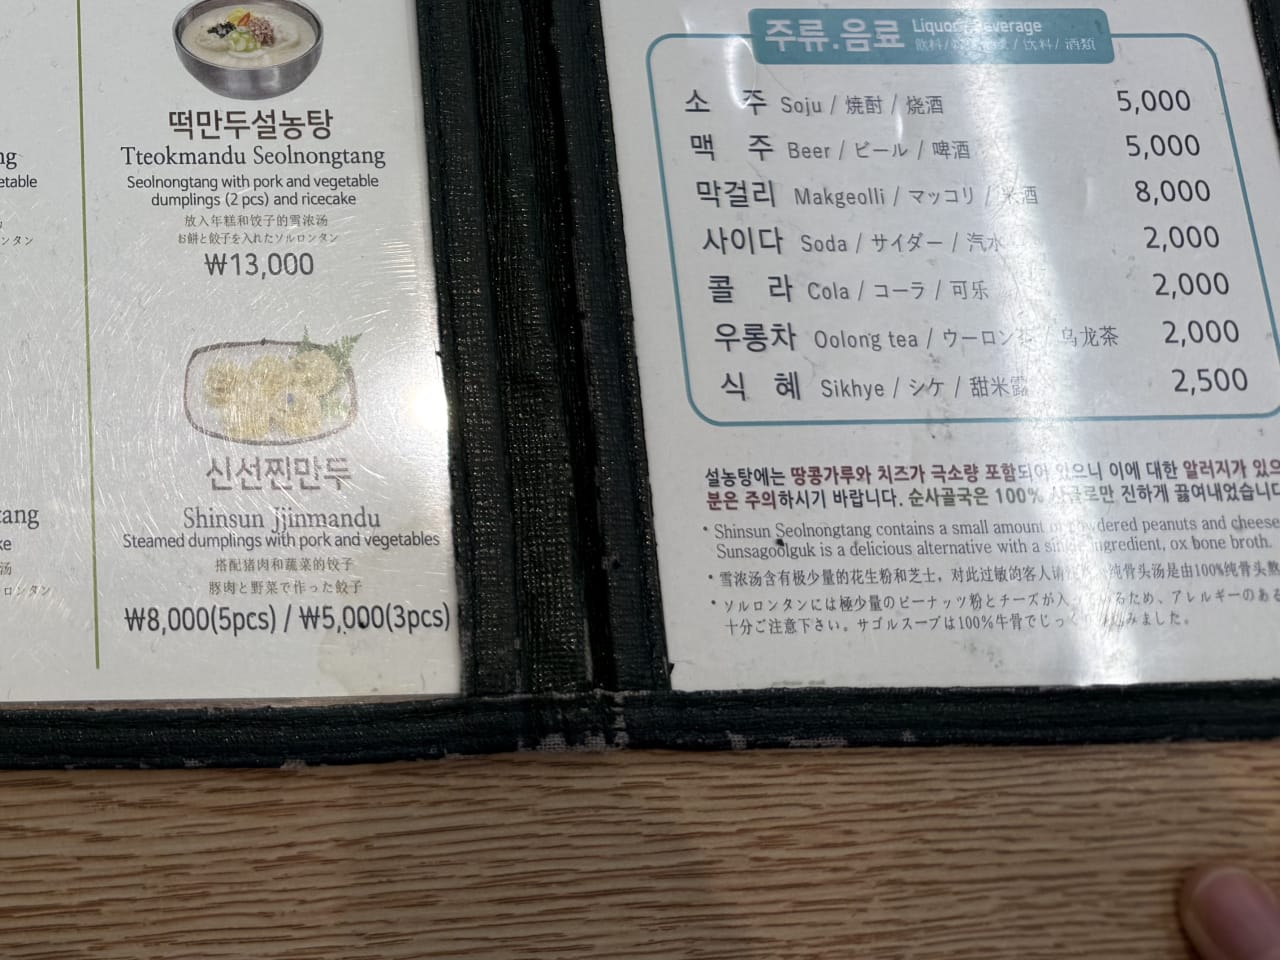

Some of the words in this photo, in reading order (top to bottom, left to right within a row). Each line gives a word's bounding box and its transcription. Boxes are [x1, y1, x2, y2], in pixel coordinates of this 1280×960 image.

[764, 18, 905, 53] 주류.음료
[780, 95, 823, 117] Soju
[1116, 89, 1191, 116] 5,000
[168, 108, 334, 141] 떡만두설농탕
[120, 144, 247, 166] Tteokmandu
[253, 143, 386, 170] Seolnongtang
[787, 141, 831, 160] Beer
[854, 140, 909, 159] ビール
[1125, 134, 1201, 161] 5,000
[695, 179, 776, 209] 막걸리
[793, 186, 885, 209] Makgeolli
[908, 186, 974, 206] マッコリ
[1134, 179, 1211, 206] 8,000
[702, 226, 784, 256] 사이다
[800, 234, 848, 253] Soda
[1143, 225, 1220, 253] 2,000
[807, 281, 850, 301] Cola
[873, 281, 925, 300] コーラ
[949, 279, 989, 301] 可乐
[1152, 271, 1230, 300] 2,000
[714, 322, 797, 353] 우롱차
[814, 329, 883, 352] Oolong
[887, 330, 919, 349] tea
[1162, 319, 1240, 348] 2,000
[820, 378, 885, 401] Sikhye
[1171, 367, 1248, 397] 2,500
[713, 523, 771, 541] Shinsun
[775, 522, 872, 540] Seolnongtang
[876, 520, 935, 536] contains
